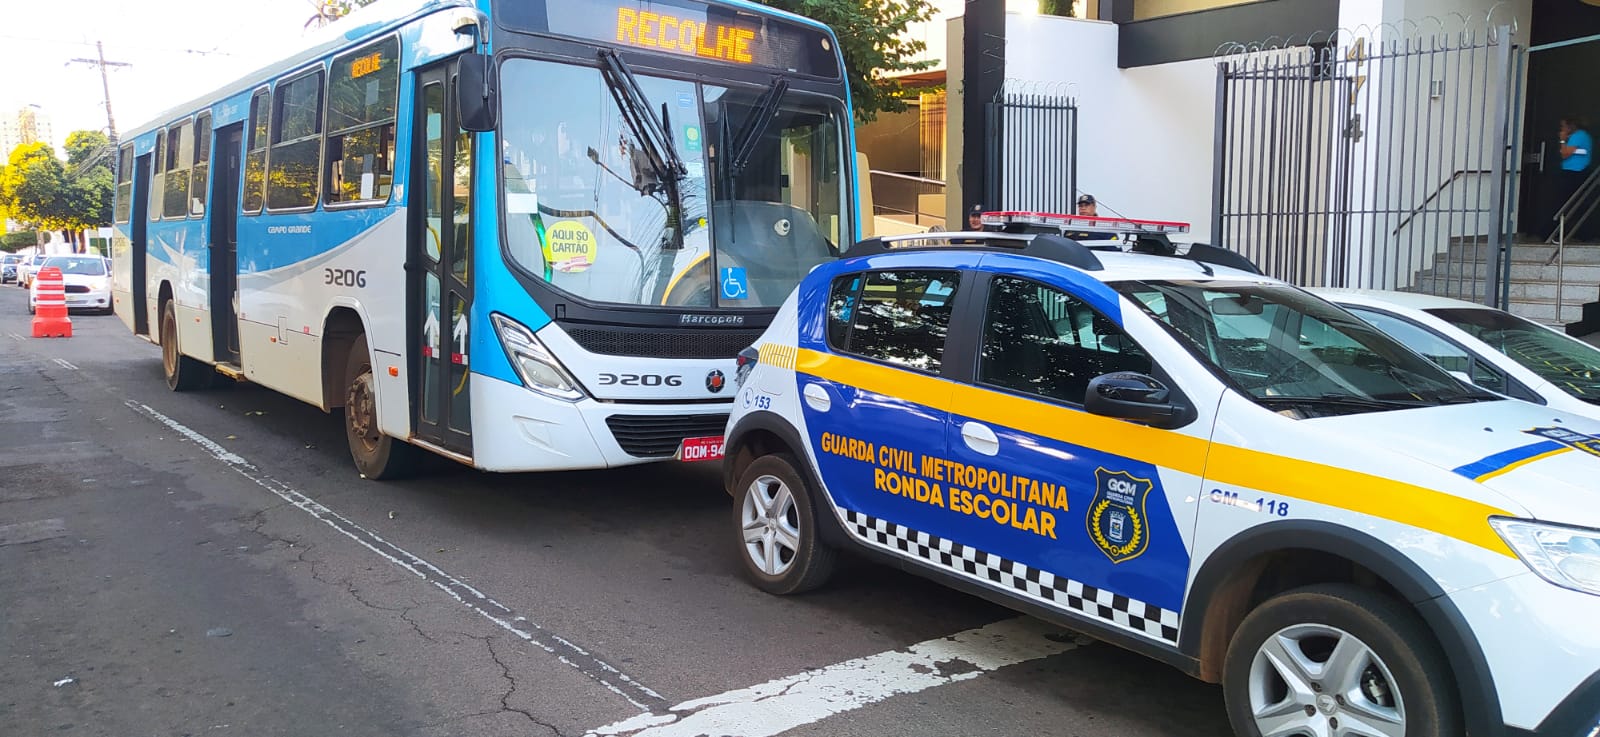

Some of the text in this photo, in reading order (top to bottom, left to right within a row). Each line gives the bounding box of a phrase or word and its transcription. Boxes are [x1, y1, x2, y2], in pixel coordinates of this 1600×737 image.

[616, 7, 755, 63] RECOLHE
[267, 225, 311, 234] CAMPO GRANDE
[552, 229, 574, 241] AQUI
[325, 268, 366, 289] 3206
[681, 314, 744, 325] Marcopolo
[598, 373, 682, 387] 3206
[754, 395, 771, 410] 153
[821, 431, 1069, 512] GUARDA CIVIL METROPOLITANA
[1107, 478, 1137, 496] GCM
[874, 468, 1057, 540] RONDA ESCOLAR
[1210, 488, 1238, 506] GM
[1255, 497, 1289, 517] 118
